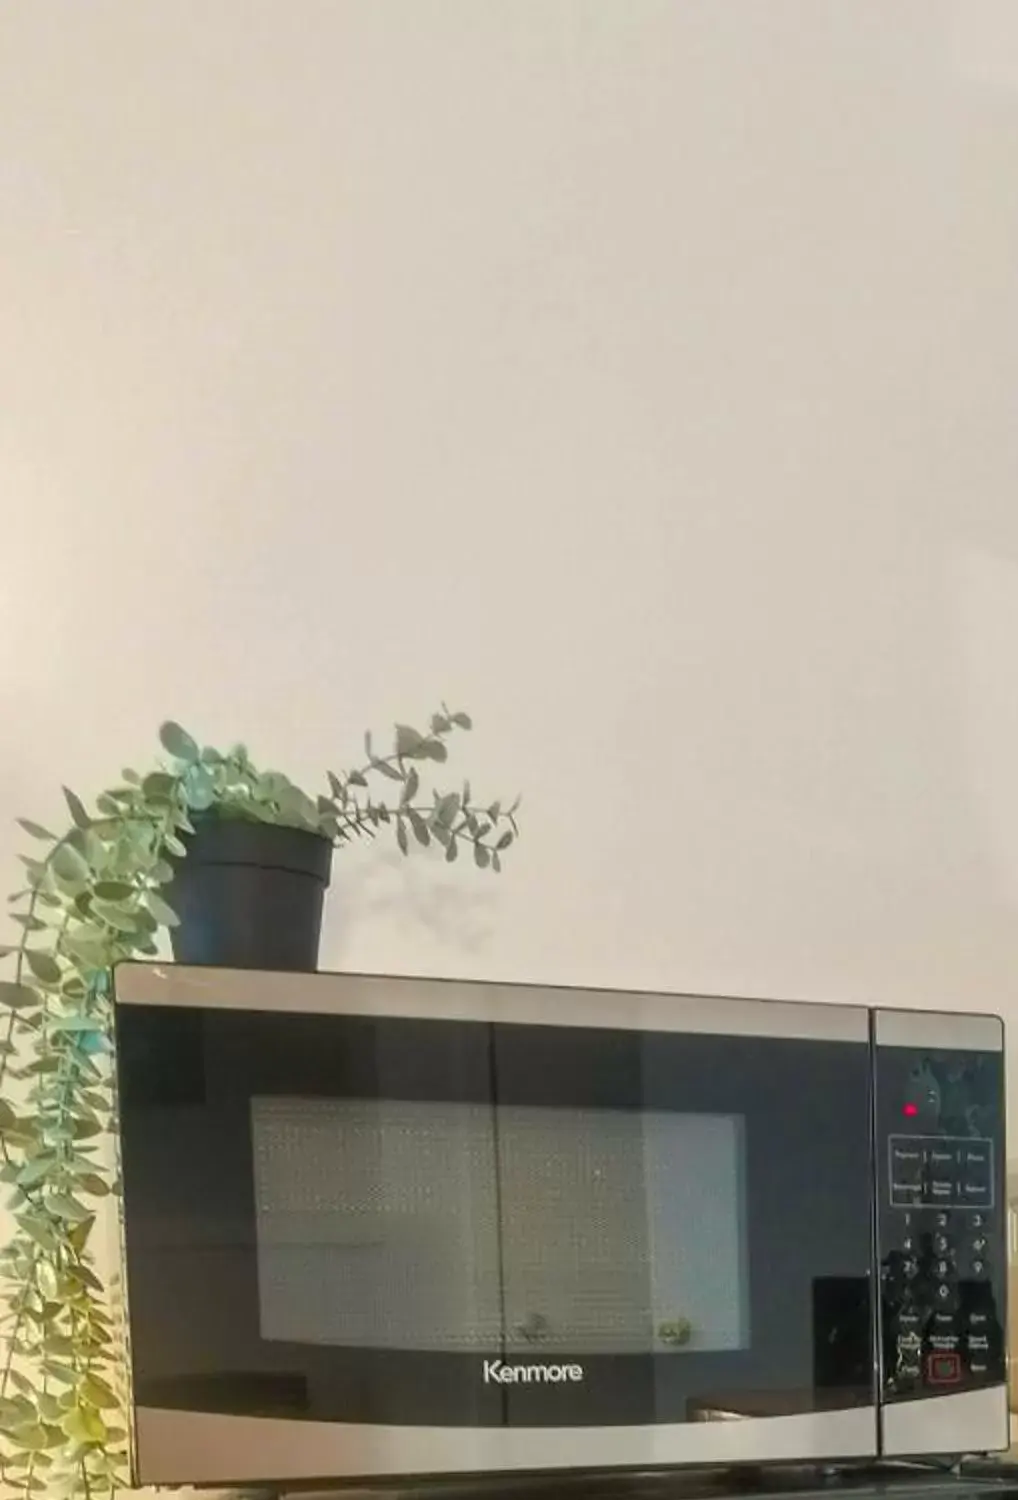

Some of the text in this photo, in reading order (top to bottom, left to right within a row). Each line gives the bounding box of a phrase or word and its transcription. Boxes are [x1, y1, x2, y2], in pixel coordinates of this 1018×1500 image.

[937, 1213, 947, 1226] 2
[972, 1214, 982, 1227] 3
[483, 1360, 584, 1383] Kenmore
